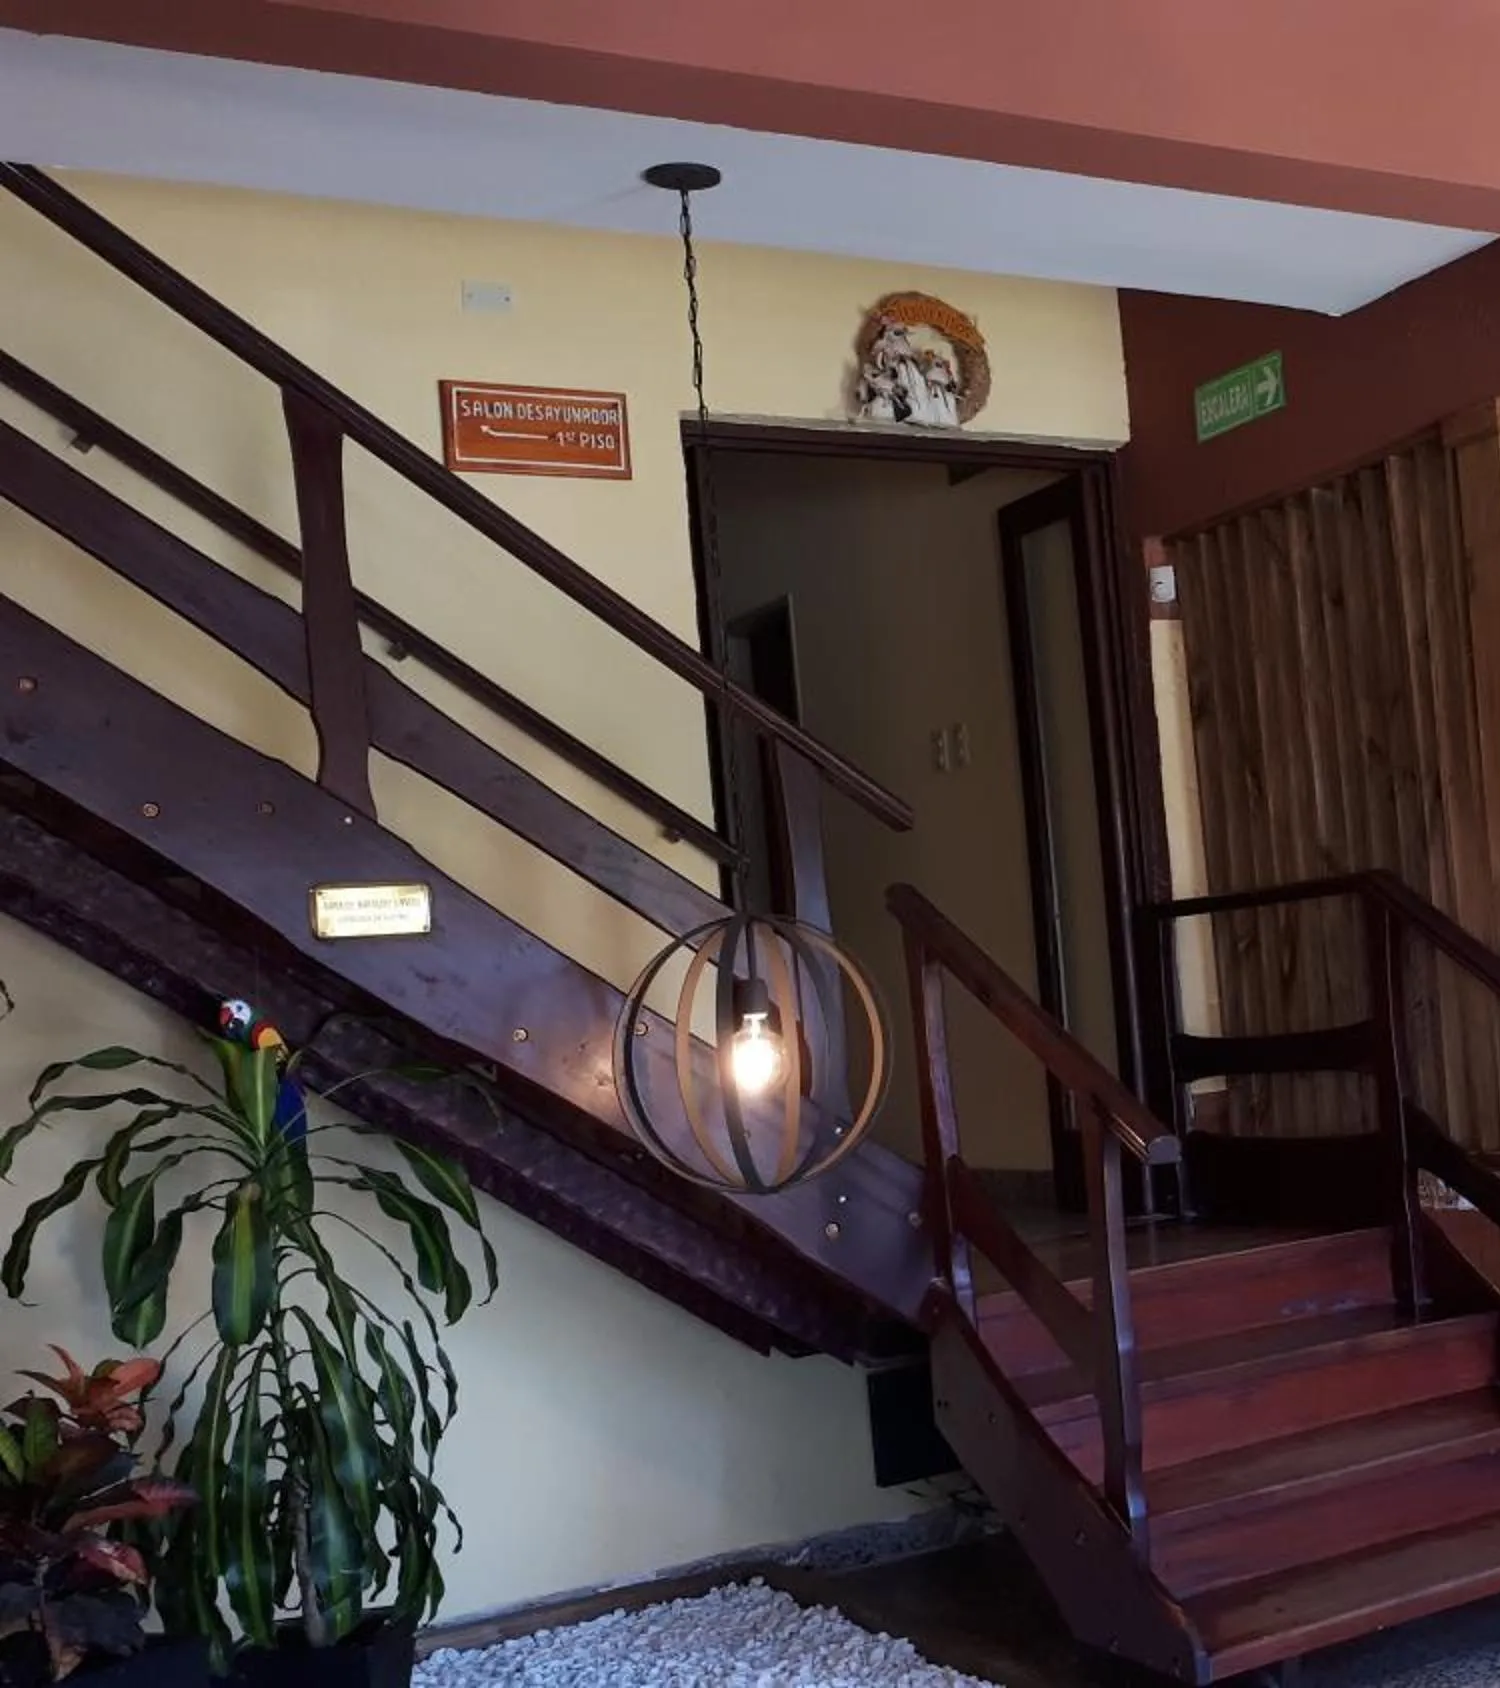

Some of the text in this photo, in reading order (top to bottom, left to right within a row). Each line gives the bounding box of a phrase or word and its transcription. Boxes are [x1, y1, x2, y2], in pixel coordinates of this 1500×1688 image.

[460, 399, 620, 426] SALON DESAYUNADOR
[1201, 382, 1249, 427] ESCALERA
[579, 431, 615, 450] PISO
